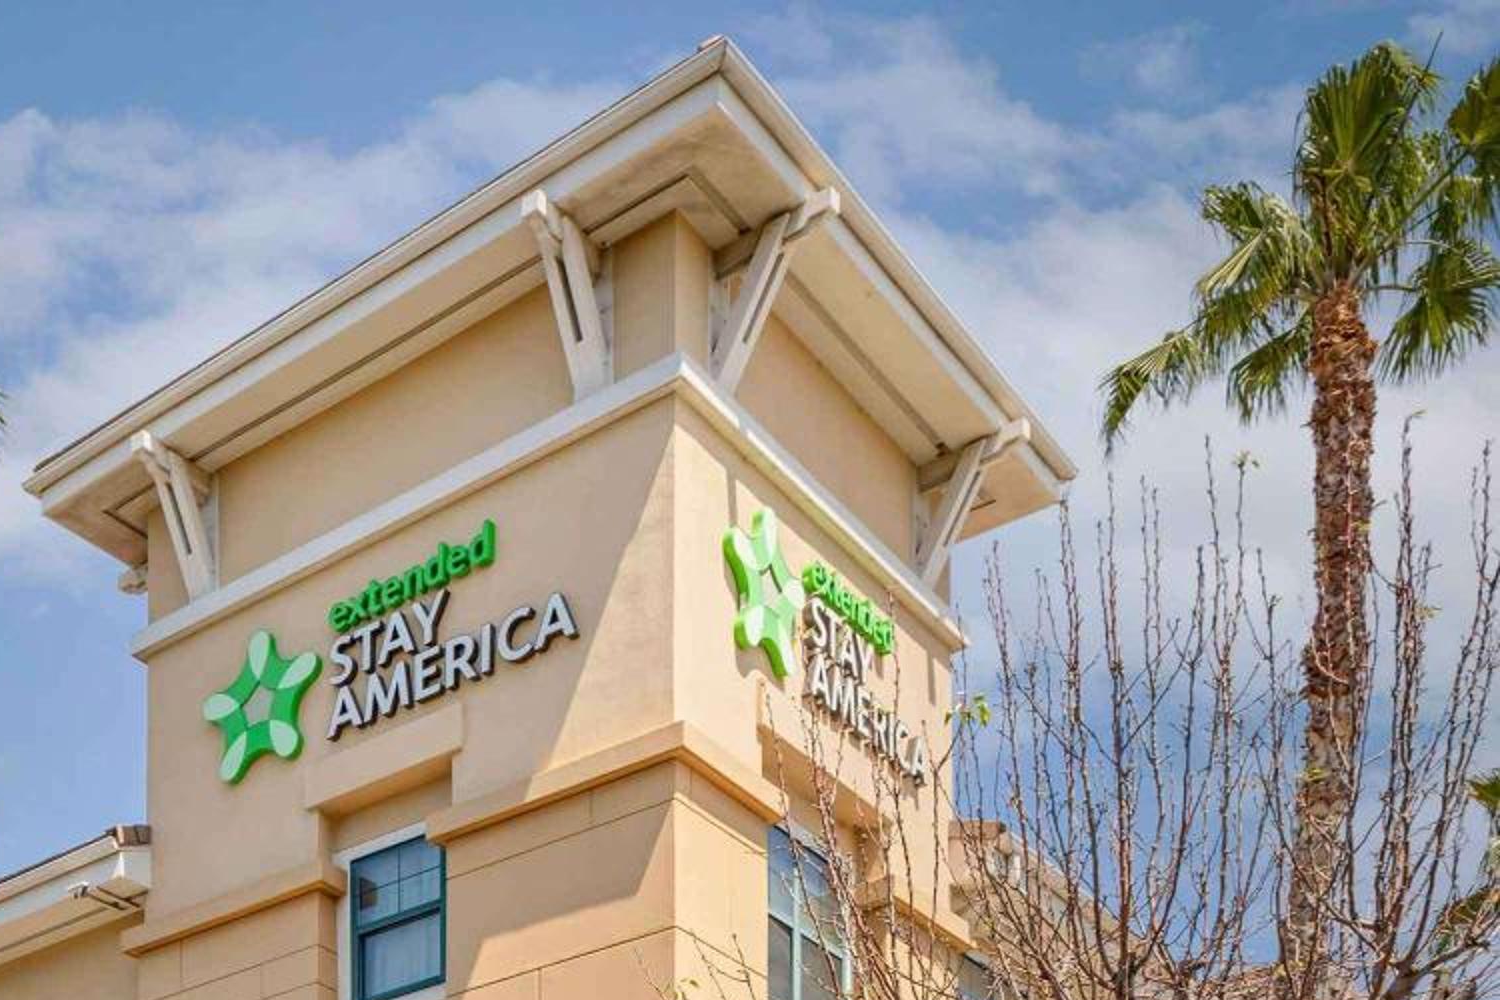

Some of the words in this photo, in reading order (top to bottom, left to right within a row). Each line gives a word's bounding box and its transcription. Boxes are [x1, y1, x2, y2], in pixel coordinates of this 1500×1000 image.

[326, 518, 496, 632] extended
[326, 591, 580, 742] AMERICA
[328, 588, 451, 688] STAY
[803, 596, 873, 686] STAY
[803, 652, 927, 786] AMERICA
